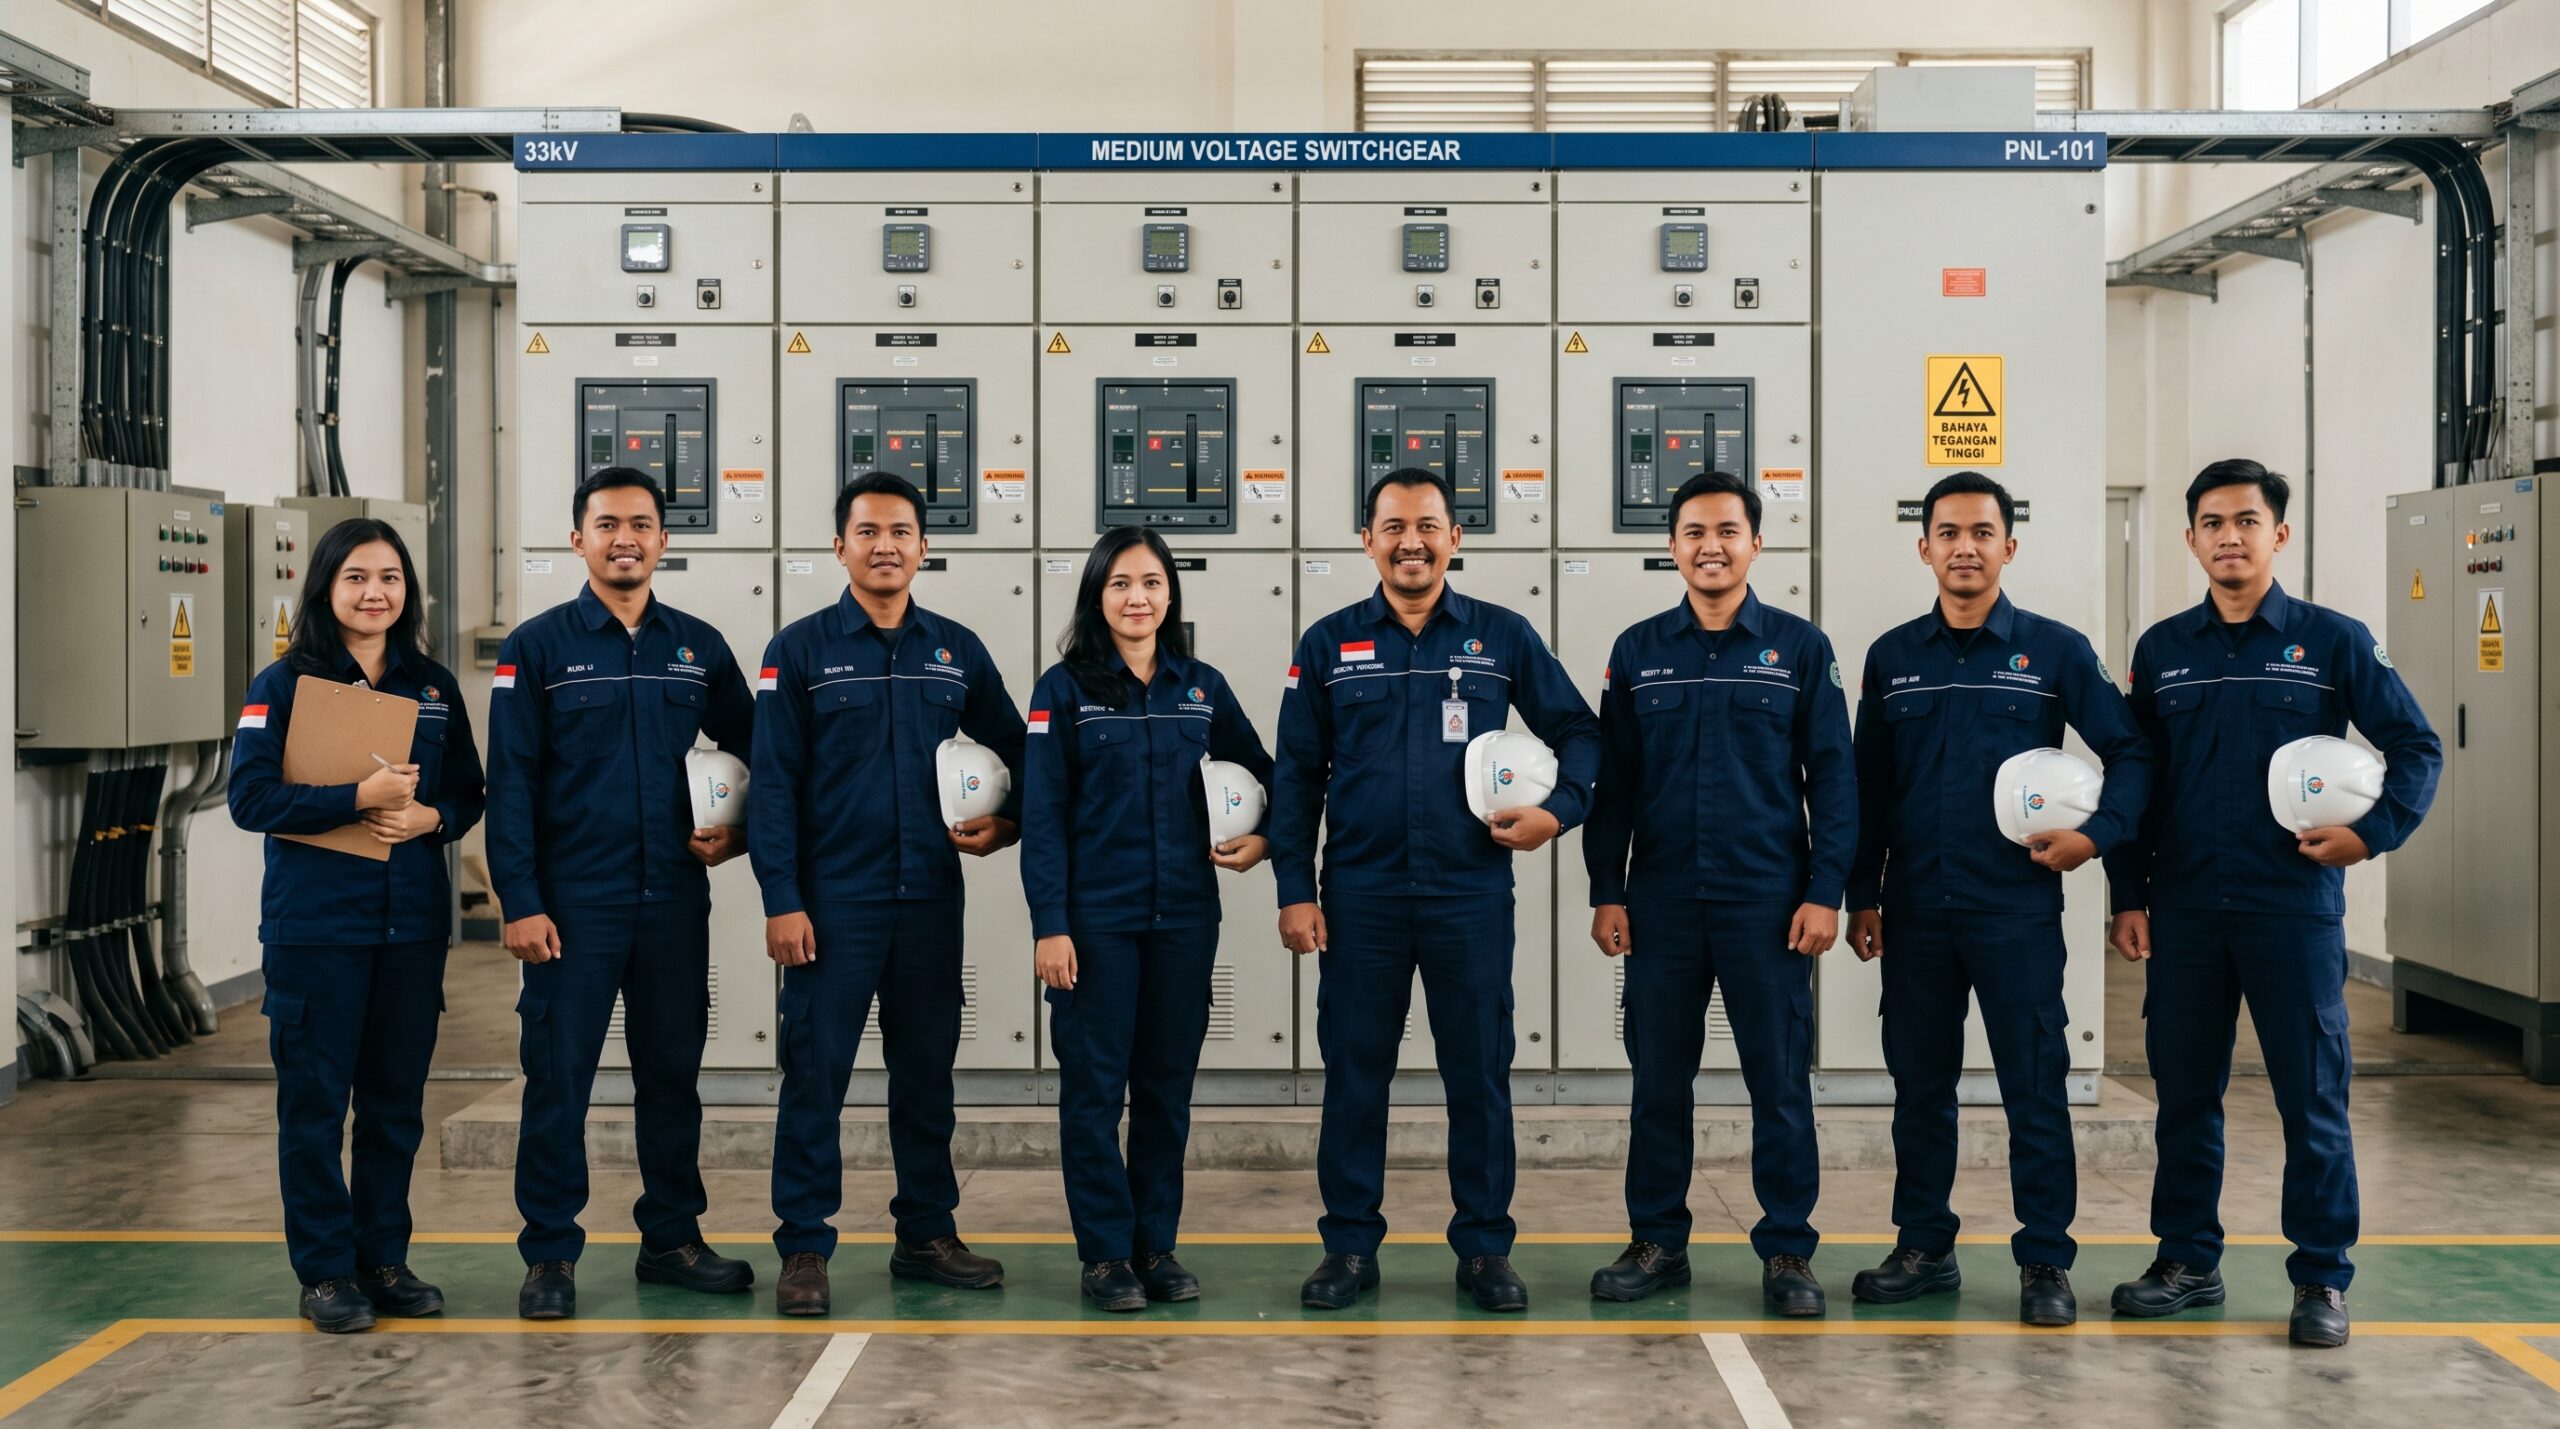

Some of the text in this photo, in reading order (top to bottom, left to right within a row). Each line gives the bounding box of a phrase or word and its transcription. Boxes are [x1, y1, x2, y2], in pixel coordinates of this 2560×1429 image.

[524, 140, 579, 162] 33kV
[1092, 140, 1461, 162] MEDIUM VOLTAGE SWITCHGEAR
[2005, 140, 2094, 161] PNL-101
[1941, 422, 1988, 433] BAHAYA
[1932, 435, 1997, 446] TEGANGAN
[1944, 448, 1985, 459] TINGGI
